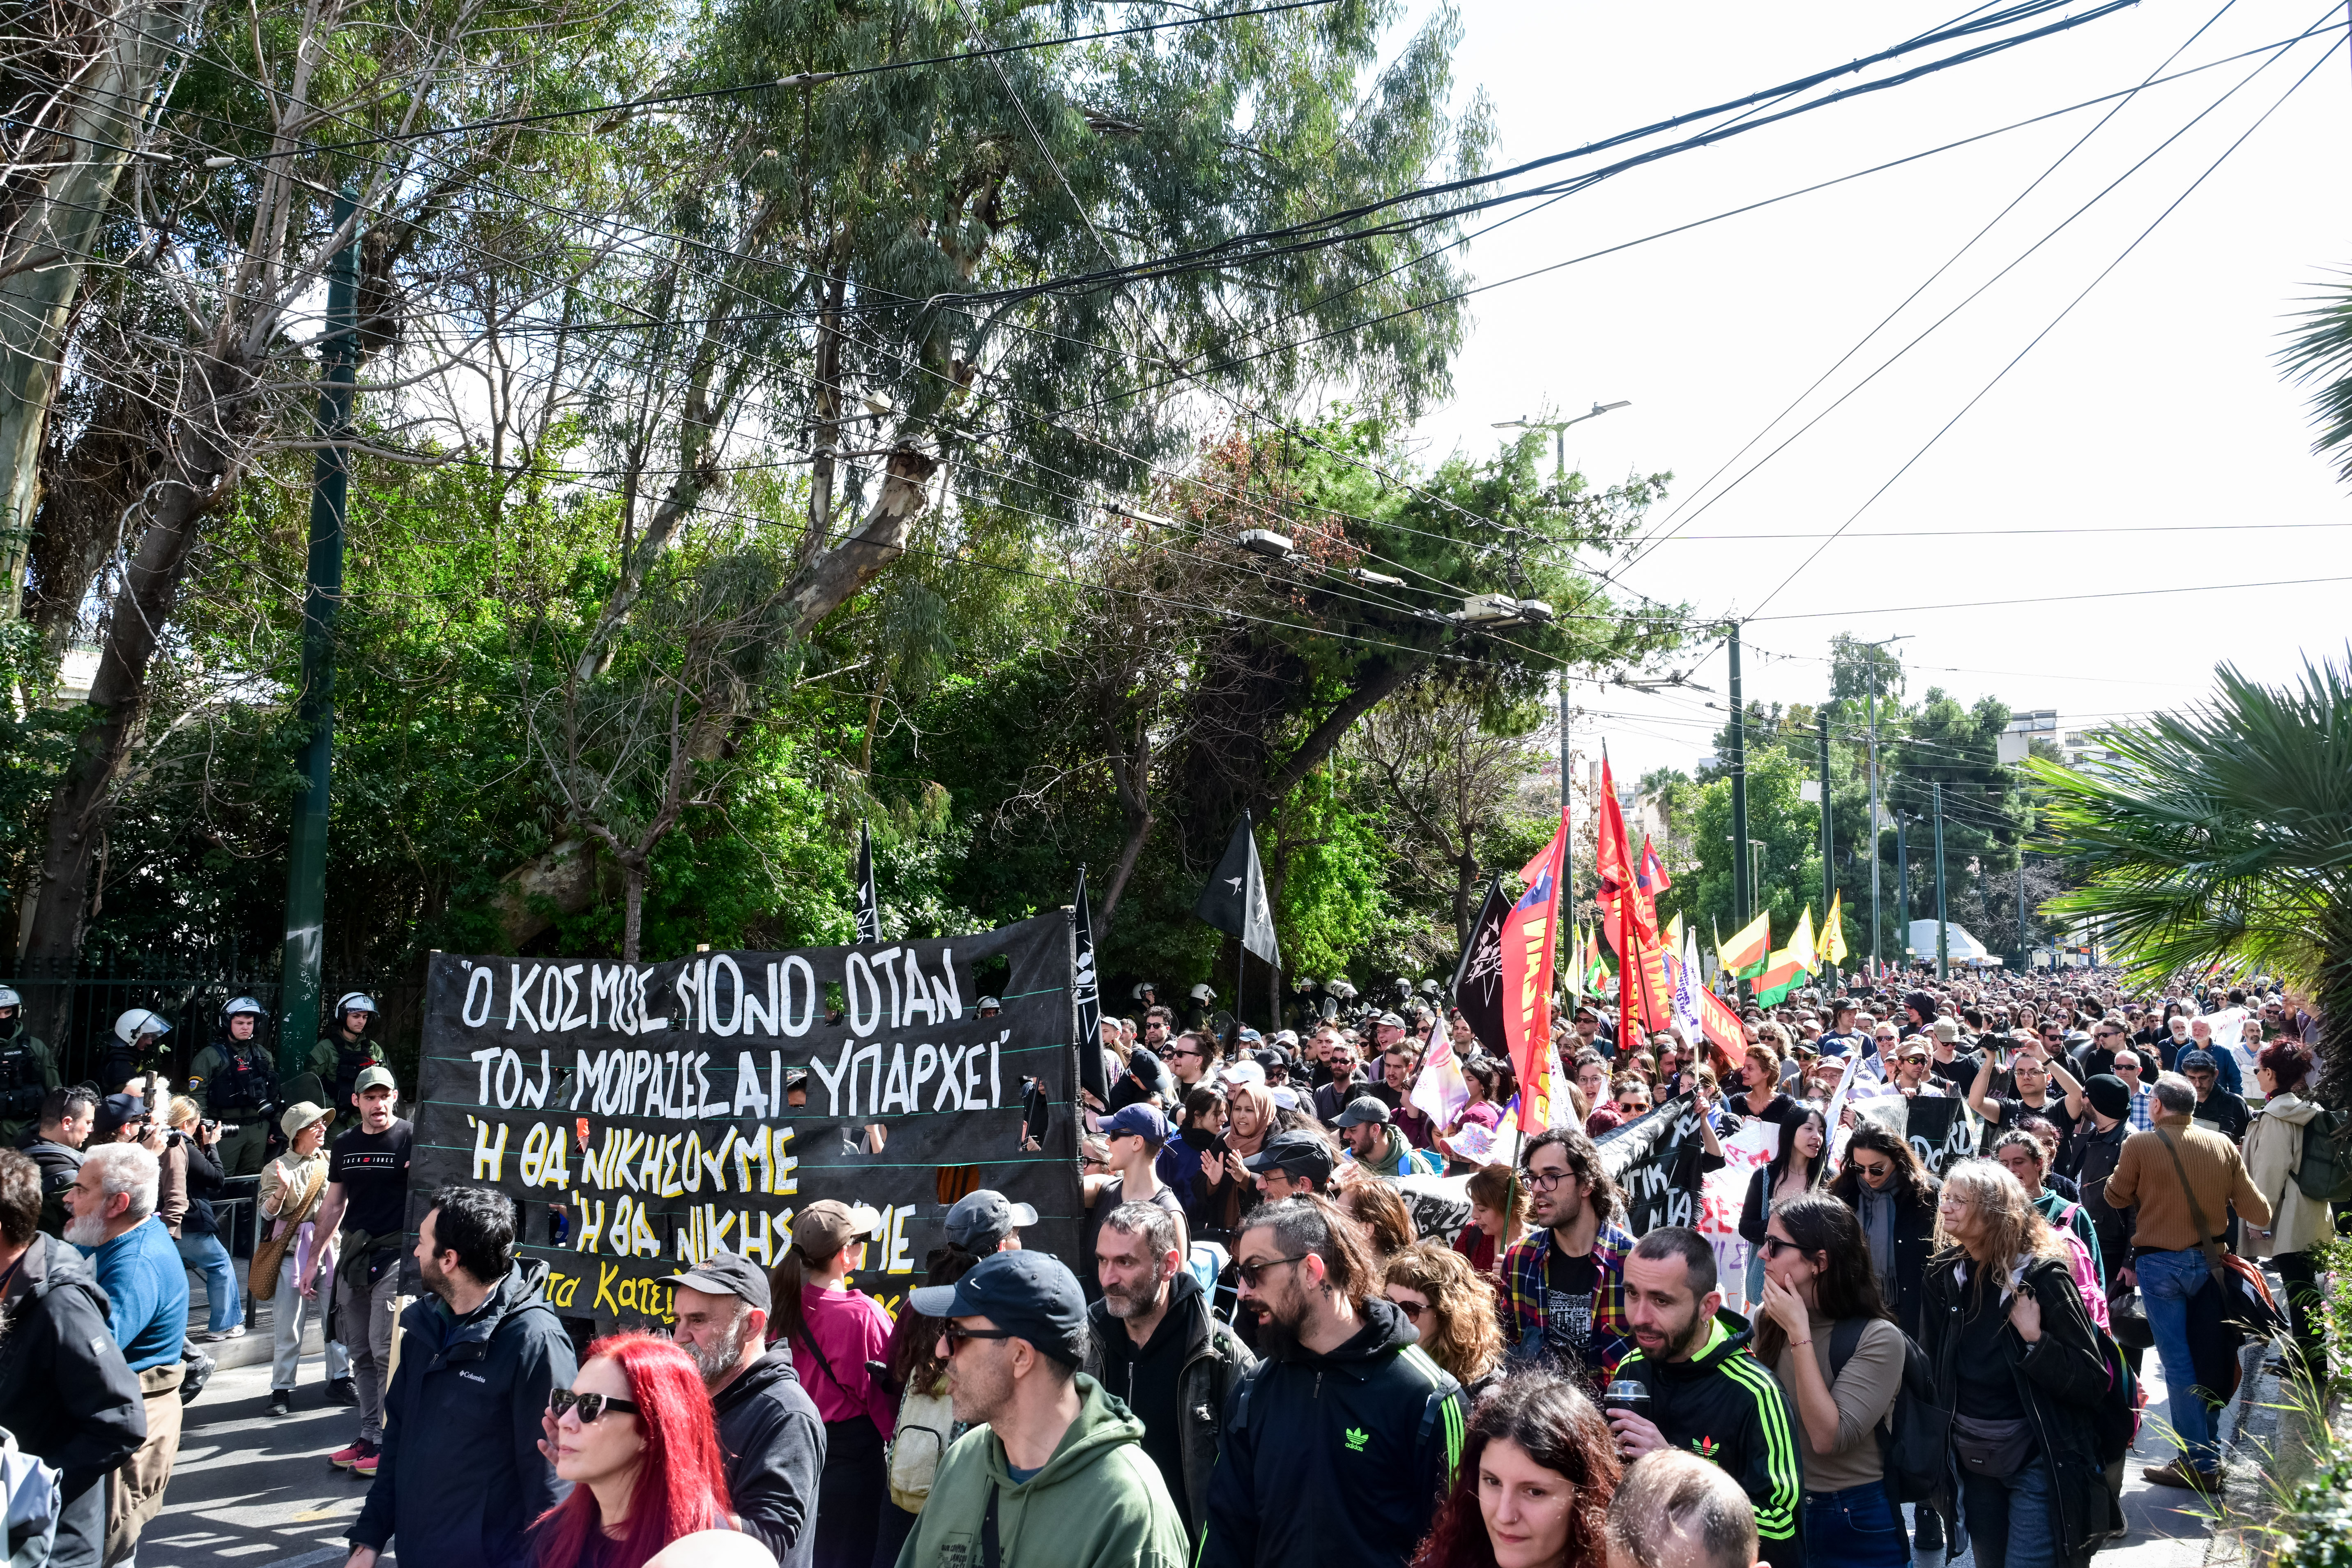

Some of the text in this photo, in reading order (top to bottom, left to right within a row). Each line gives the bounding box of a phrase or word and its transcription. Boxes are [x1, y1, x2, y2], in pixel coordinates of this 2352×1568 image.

[506, 963, 668, 1036] ΚΟΣΜΟΣ
[676, 954, 815, 1037] ΜΟΝΟ
[846, 946, 962, 1037] ΟΤΑΝ
[471, 1046, 550, 1110] ΤΟΝ
[520, 1122, 570, 1190] ΘΑ
[581, 1124, 799, 1198] ΝΙΚΗΣΟΥΜΕ
[609, 1194, 660, 1258] ΘΑ
[677, 1199, 916, 1274] ΝΙΚΗΣΜΕ
[464, 1371, 486, 1383] Columbia
[1345, 1442, 1363, 1452] adidas
